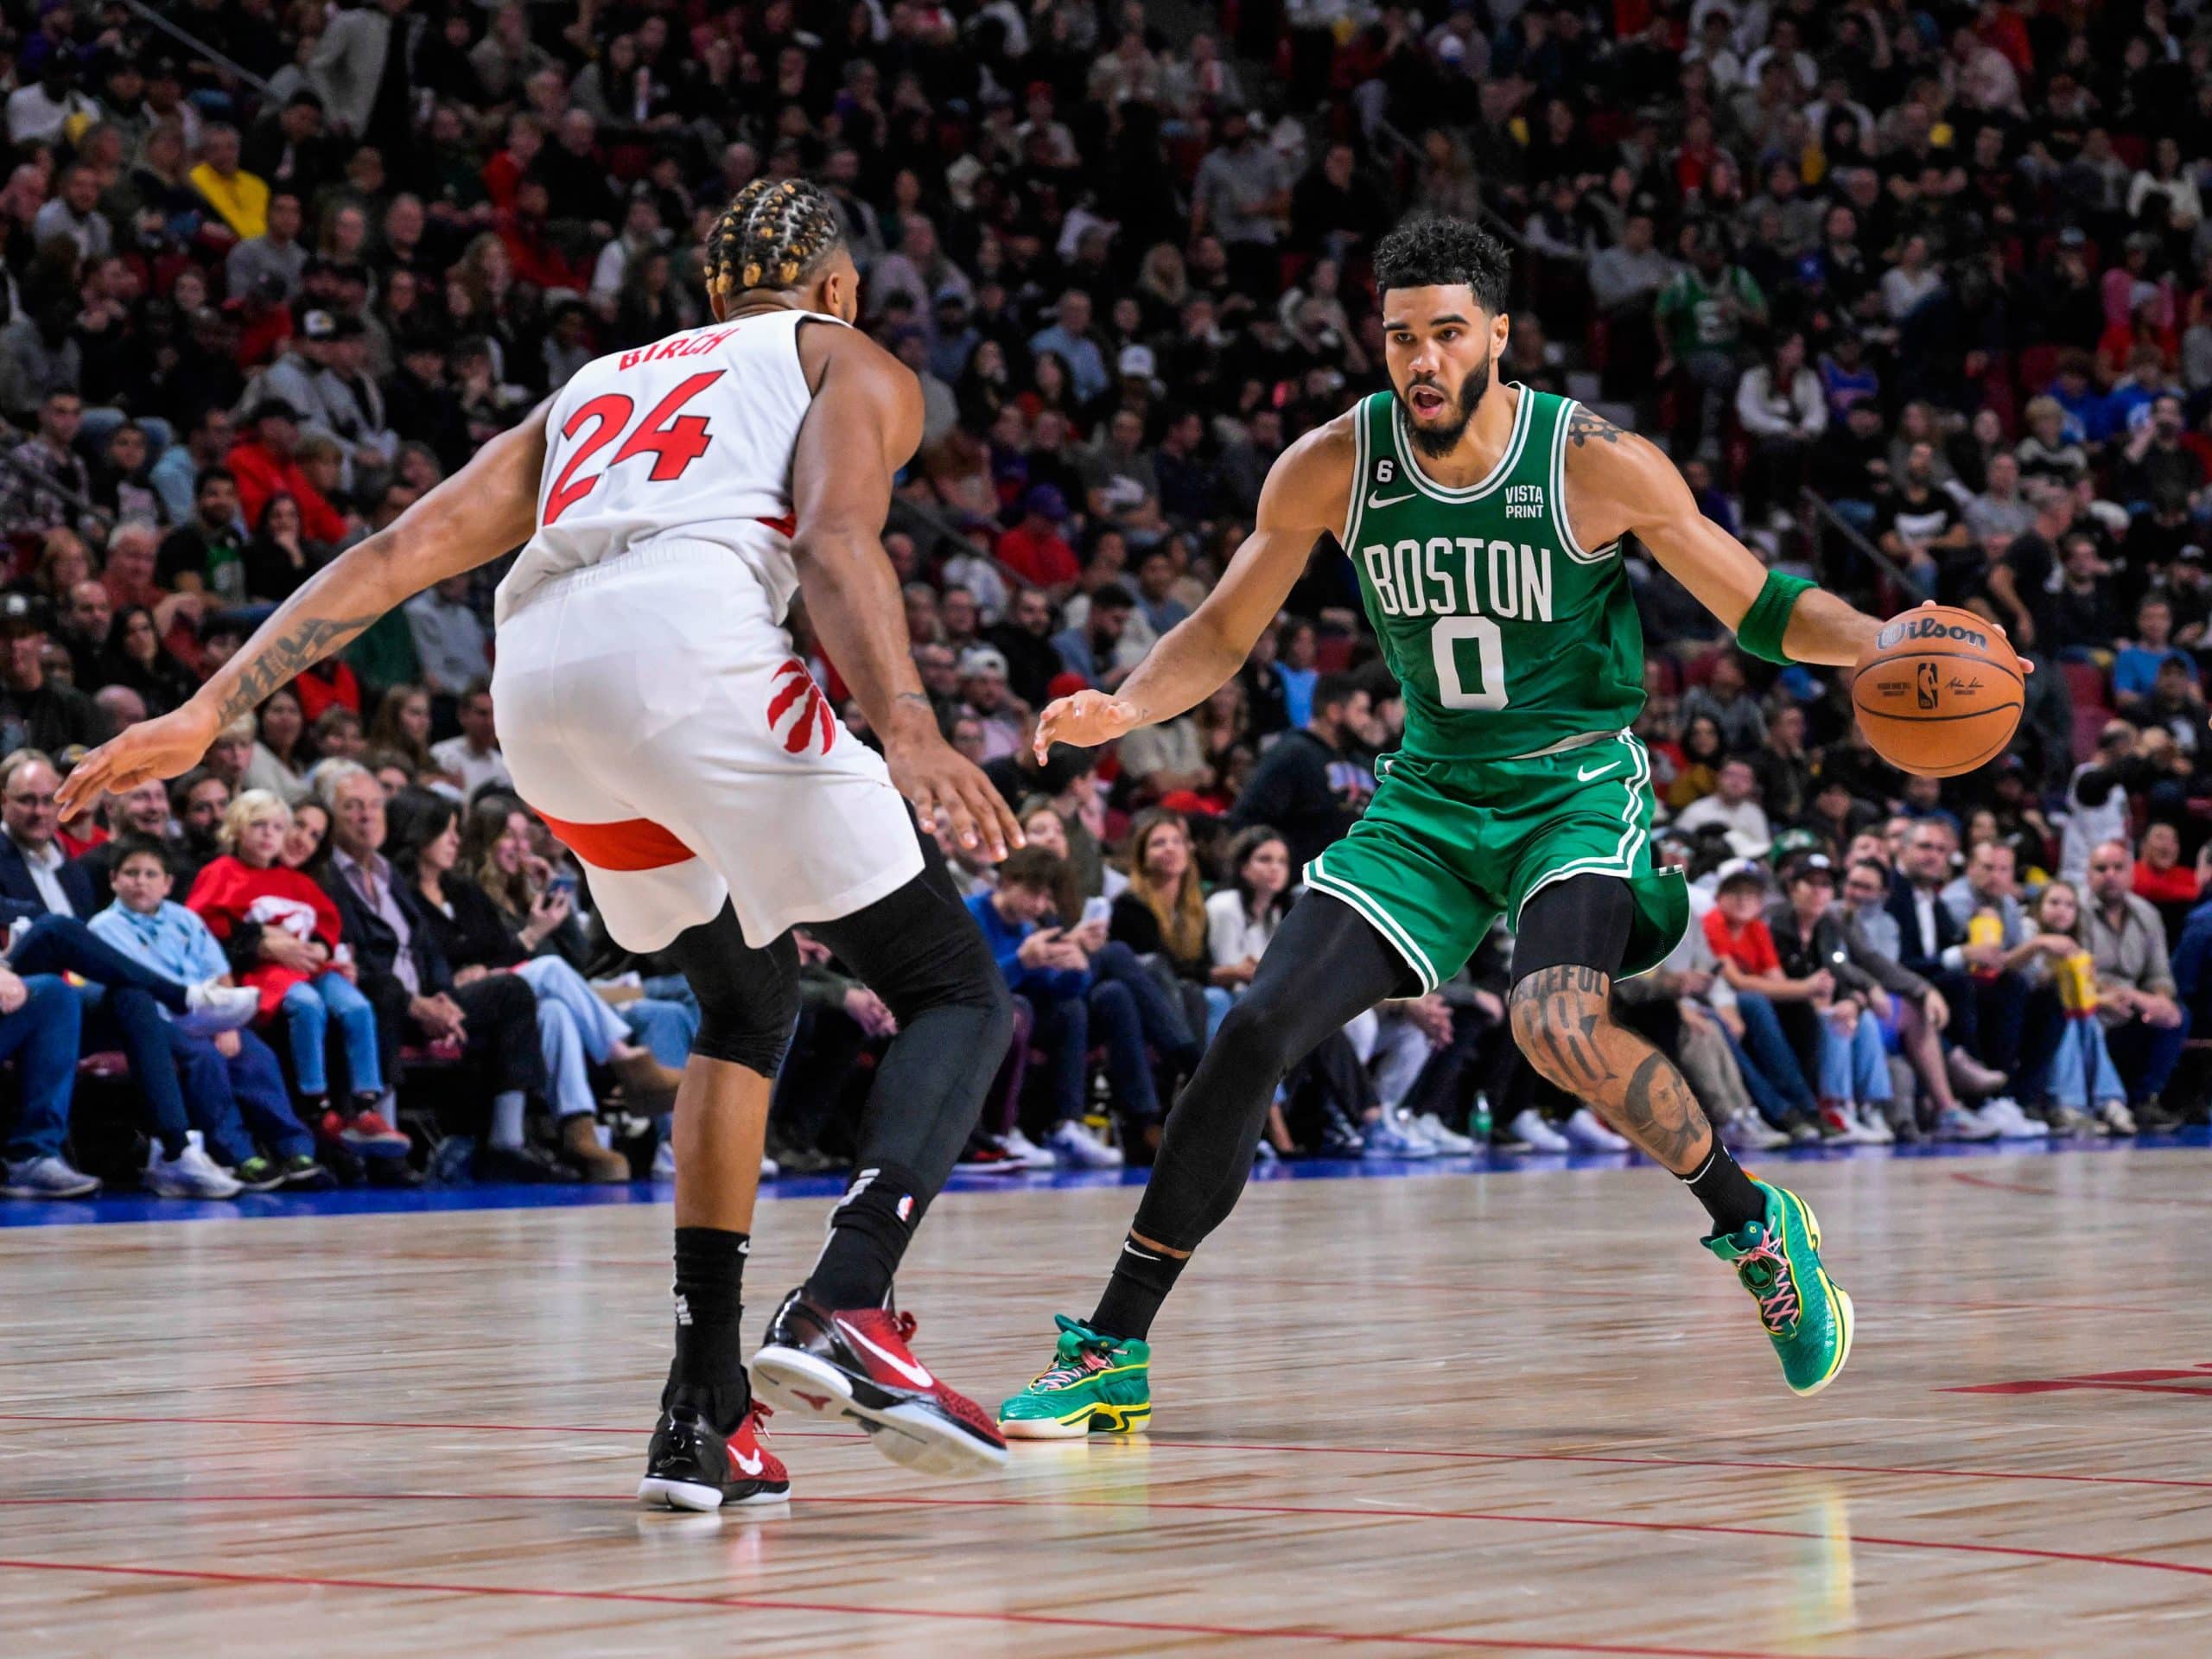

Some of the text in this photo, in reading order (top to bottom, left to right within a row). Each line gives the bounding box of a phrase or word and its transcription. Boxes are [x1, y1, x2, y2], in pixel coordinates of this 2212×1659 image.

[620, 328, 740, 371] BIRCH
[543, 369, 728, 526] 24
[1376, 460, 1394, 483] 6
[1505, 485, 1544, 505] VISTA
[1505, 505, 1544, 518] PRINT
[1363, 537, 1552, 622] BOSTON
[1876, 618, 1987, 651] Wilson
[1431, 616, 1510, 711] 0
